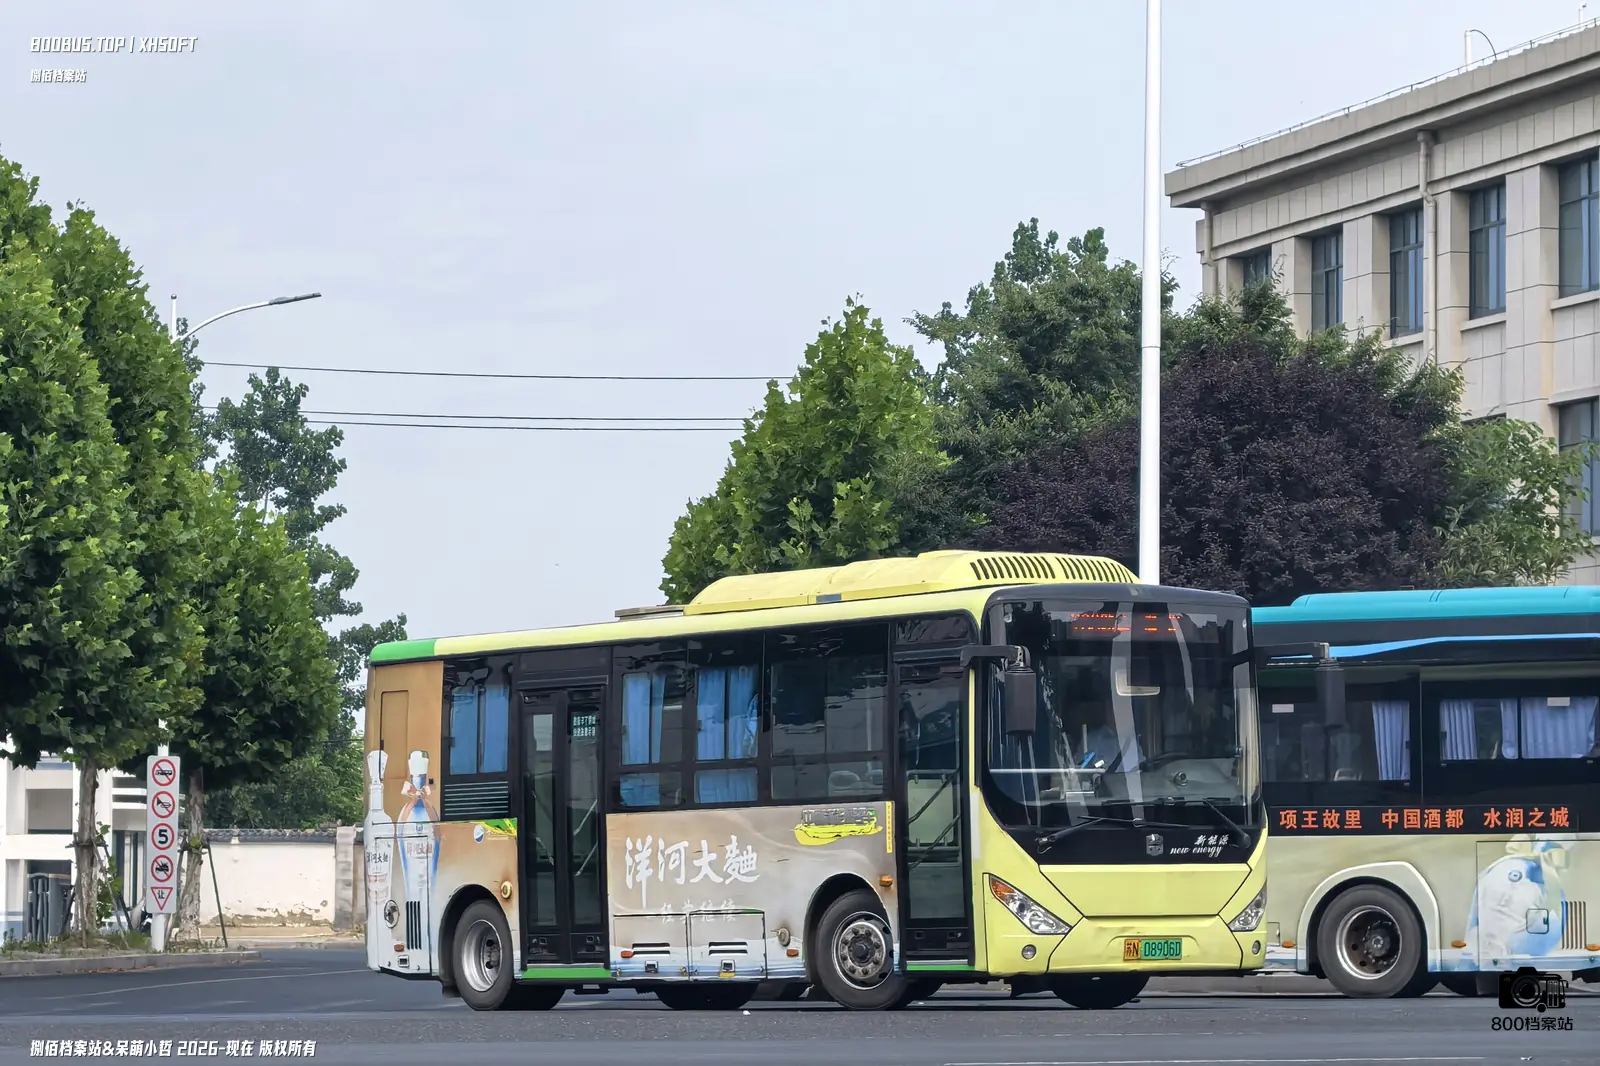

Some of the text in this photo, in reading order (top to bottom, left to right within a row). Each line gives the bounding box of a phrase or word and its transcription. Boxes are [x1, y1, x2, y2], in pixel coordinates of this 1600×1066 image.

[1279, 807, 1570, 830] 项王故里 中国酒都 水润之城
[158, 829, 168, 845] 5
[1194, 834, 1229, 846] 新能源
[1170, 846, 1223, 858] new energy
